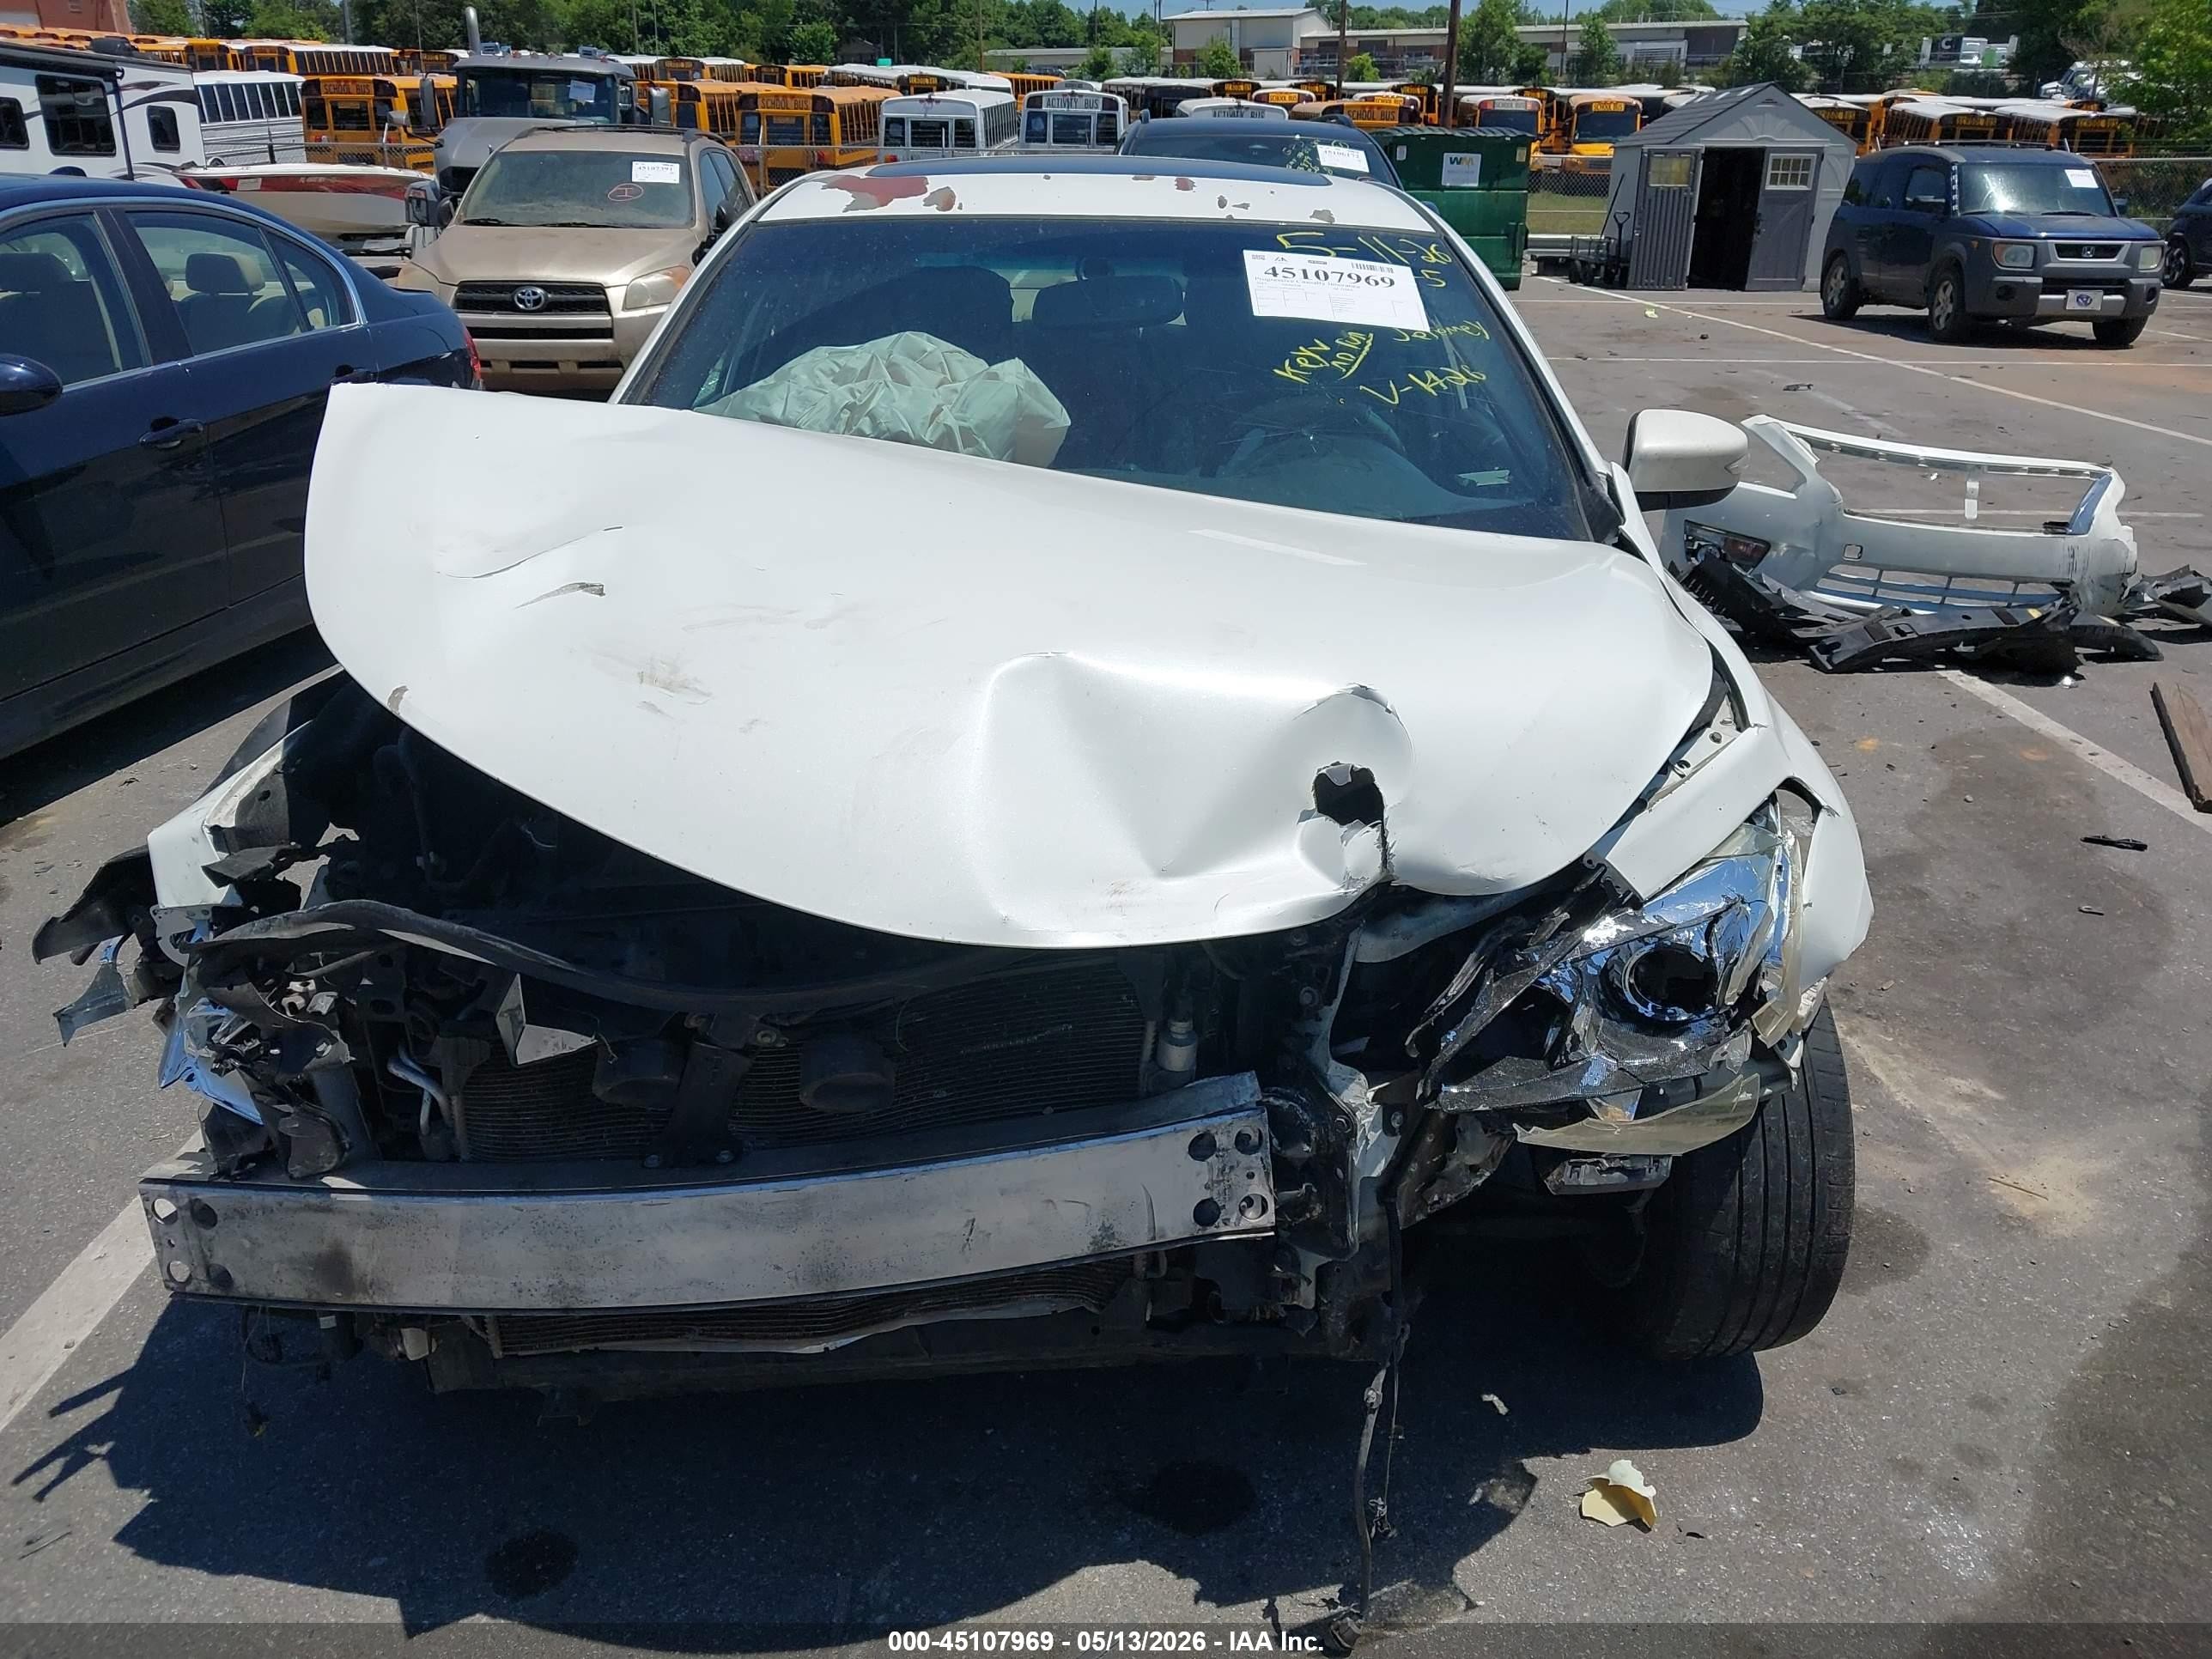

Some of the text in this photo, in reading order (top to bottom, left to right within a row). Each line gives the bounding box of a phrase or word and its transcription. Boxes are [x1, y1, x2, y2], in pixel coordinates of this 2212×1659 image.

[324, 83, 370, 94] SCHOOL BUS
[761, 98, 809, 110] SCHOOL BUS
[1047, 97, 1098, 109] ACTIVITY BUS
[1347, 109, 1395, 120] SCHOOL BUS
[1449, 156, 1474, 166] WM
[1264, 265, 1395, 289] 45107969
